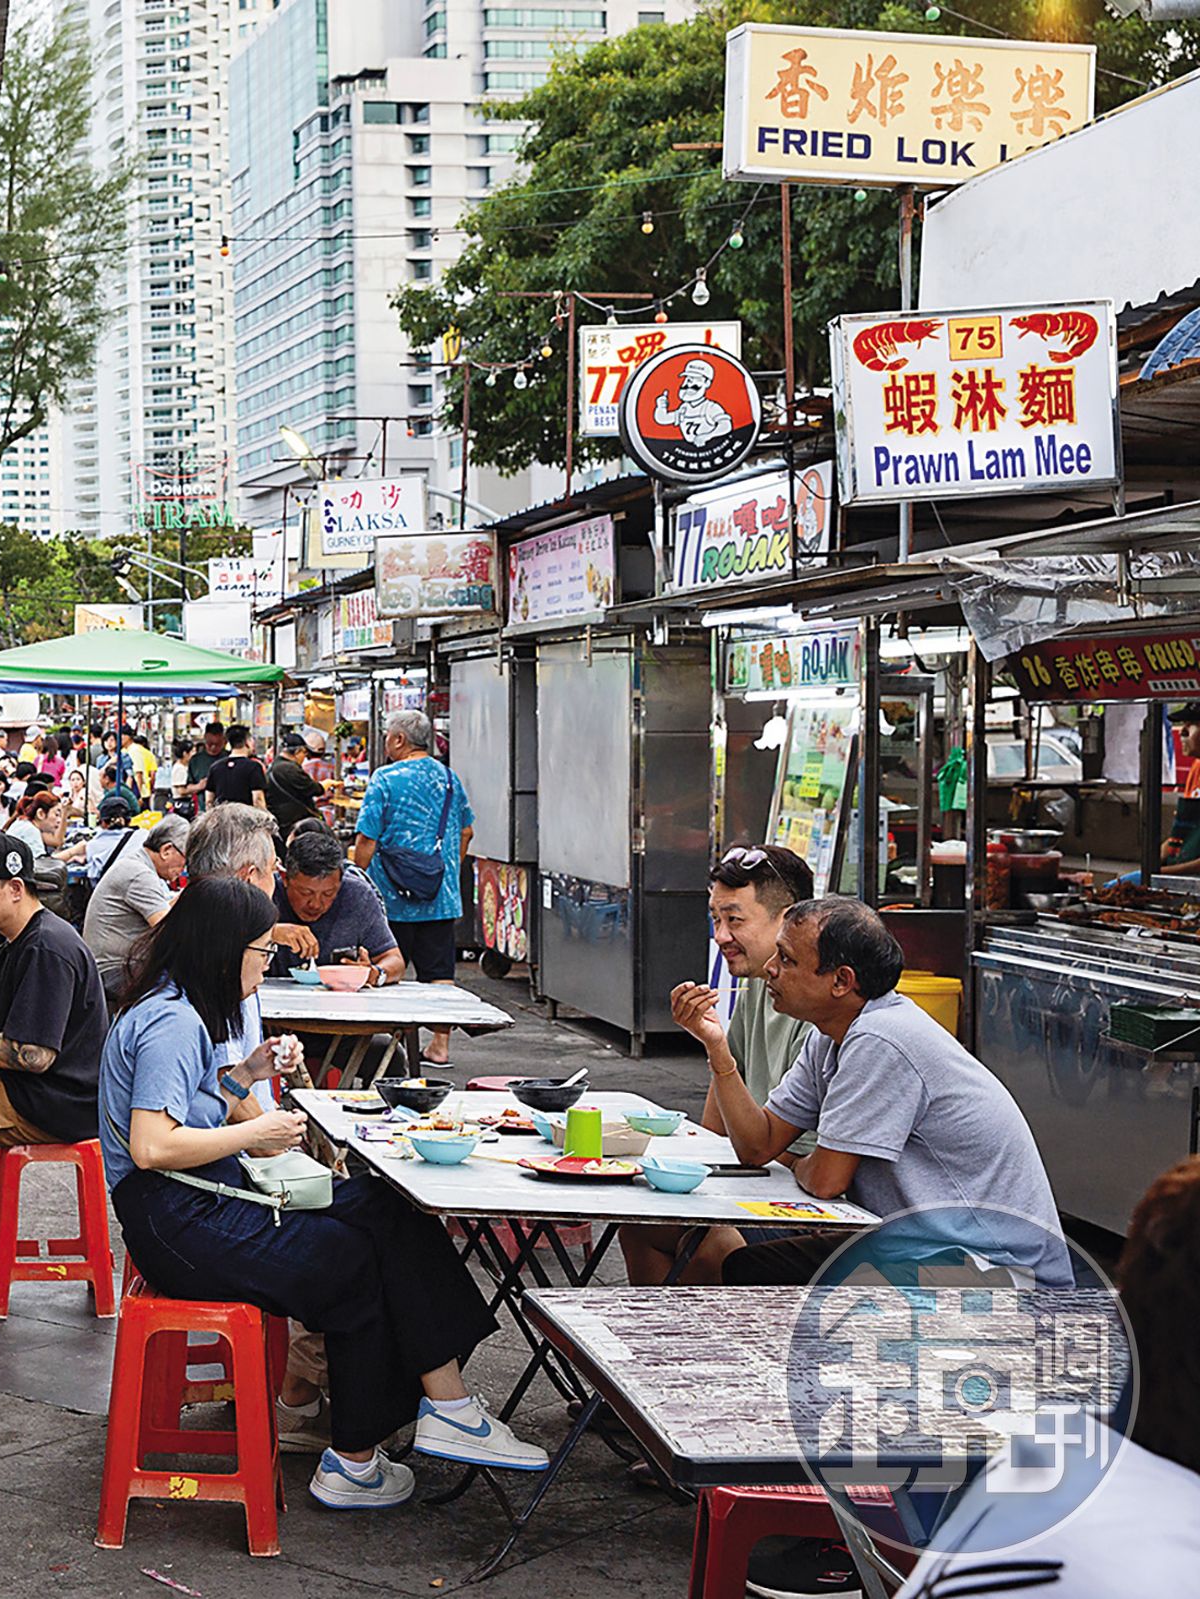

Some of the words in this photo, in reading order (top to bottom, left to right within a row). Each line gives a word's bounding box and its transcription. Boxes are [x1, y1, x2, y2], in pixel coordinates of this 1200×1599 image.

[757, 126, 872, 160] FRIED
[896, 136, 976, 168] LOK
[955, 326, 997, 351] 75
[586, 364, 631, 405] 77
[881, 363, 1078, 437] 蝦淋麵
[594, 416, 617, 427] BEST
[685, 421, 702, 436] 77
[873, 444, 960, 488] Prawn
[966, 438, 1027, 482] Lam
[1033, 433, 1093, 477] Mee
[340, 484, 403, 510] 叻沙
[326, 536, 362, 549] GURNEY
[337, 512, 408, 533] LAKSA
[677, 506, 708, 588] 77
[700, 530, 790, 584] ROJAK
[214, 583, 251, 591] ASAM
[800, 636, 849, 682] ROJAK
[1054, 645, 1144, 690] 香炸串串
[1143, 638, 1195, 672] FRIED
